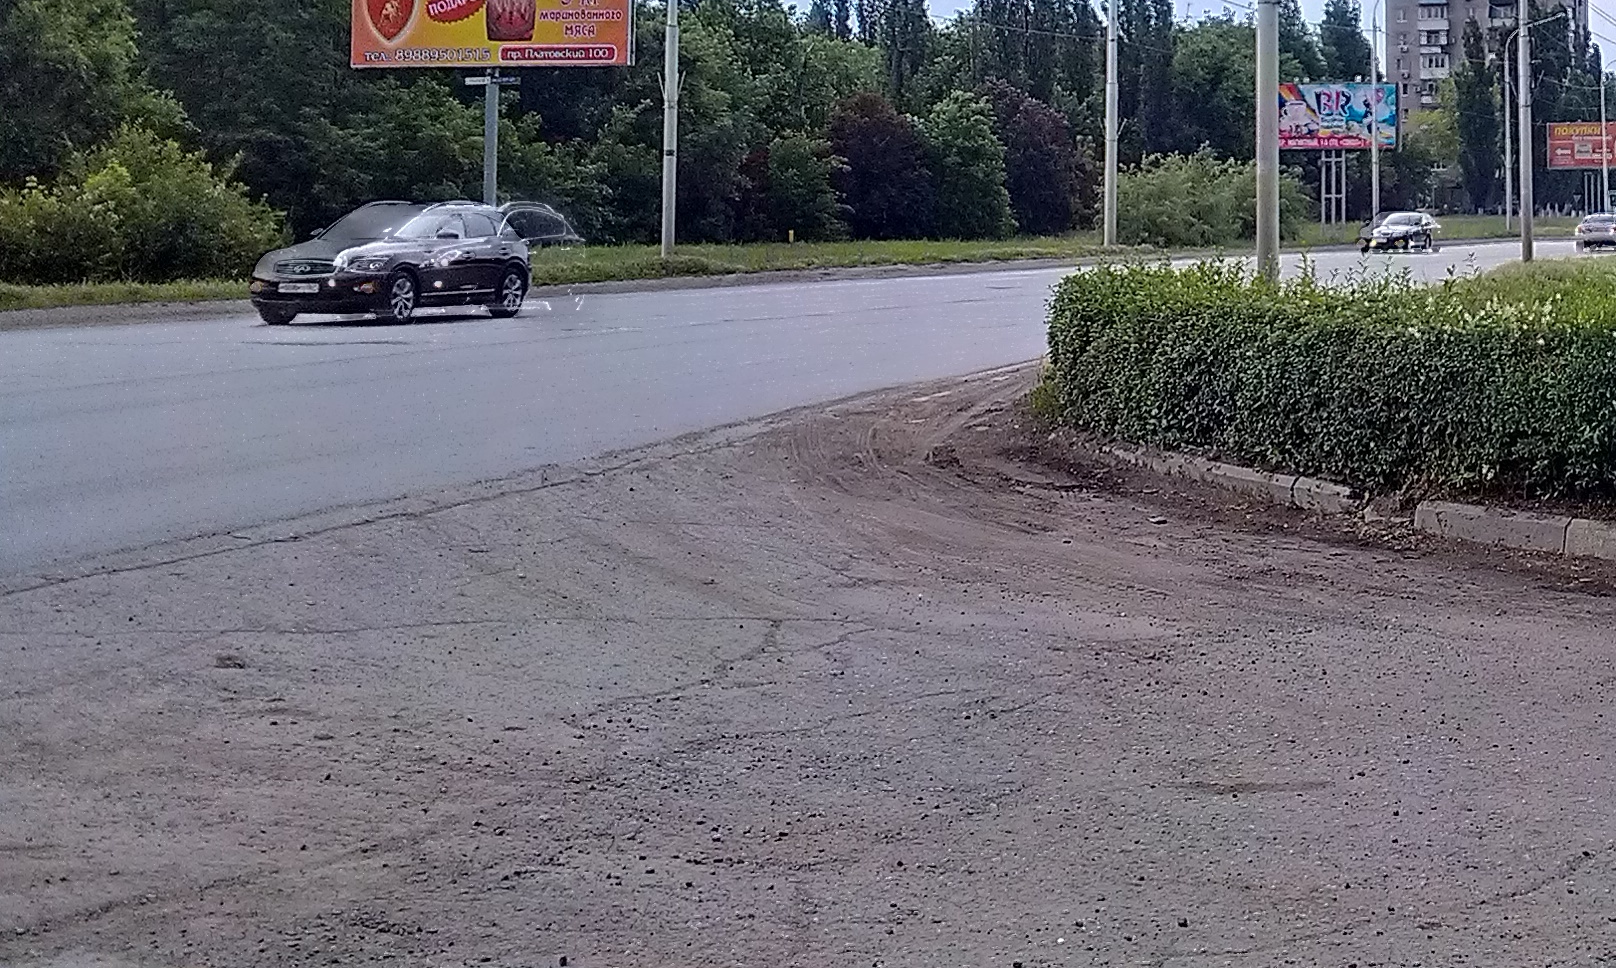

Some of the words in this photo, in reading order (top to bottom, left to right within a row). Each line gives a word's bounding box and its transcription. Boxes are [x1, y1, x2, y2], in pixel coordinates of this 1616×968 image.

[364, 51, 392, 62] тел.
[394, 48, 491, 62] 89889501515
[506, 50, 522, 61] пр.
[524, 48, 586, 59] Платовский
[588, 48, 609, 59] 100
[1554, 125, 1601, 136] ПОКУПКИ
